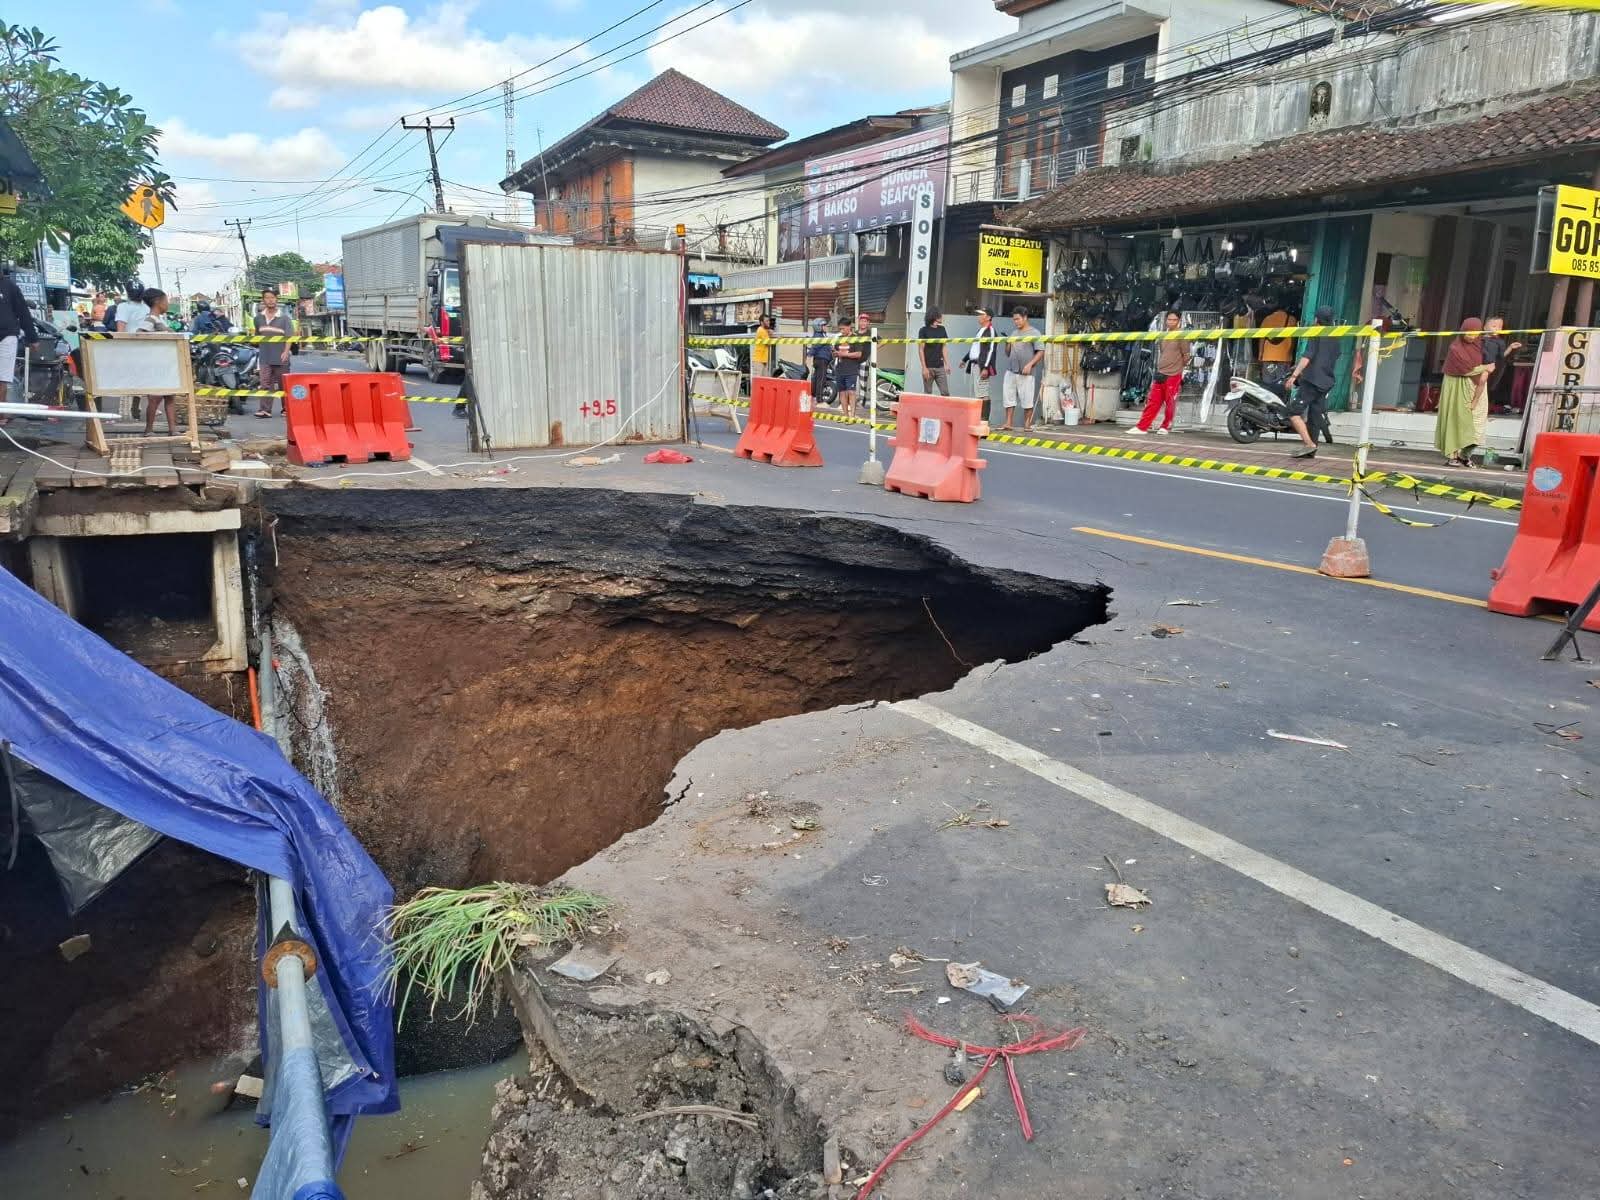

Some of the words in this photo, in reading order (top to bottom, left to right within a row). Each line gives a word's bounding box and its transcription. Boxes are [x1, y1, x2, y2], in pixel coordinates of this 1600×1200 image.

[824, 197, 858, 217] BAKSO
[983, 235, 1008, 246] TOKO
[1009, 238, 1042, 249] SEPATU
[914, 194, 931, 310] SOSIS
[995, 267, 1029, 278] SEPATU
[1572, 258, 1588, 272] 085
[1589, 260, 1600, 273] 85
[982, 278, 1014, 288] SANDAL
[1025, 281, 1039, 289] TAS
